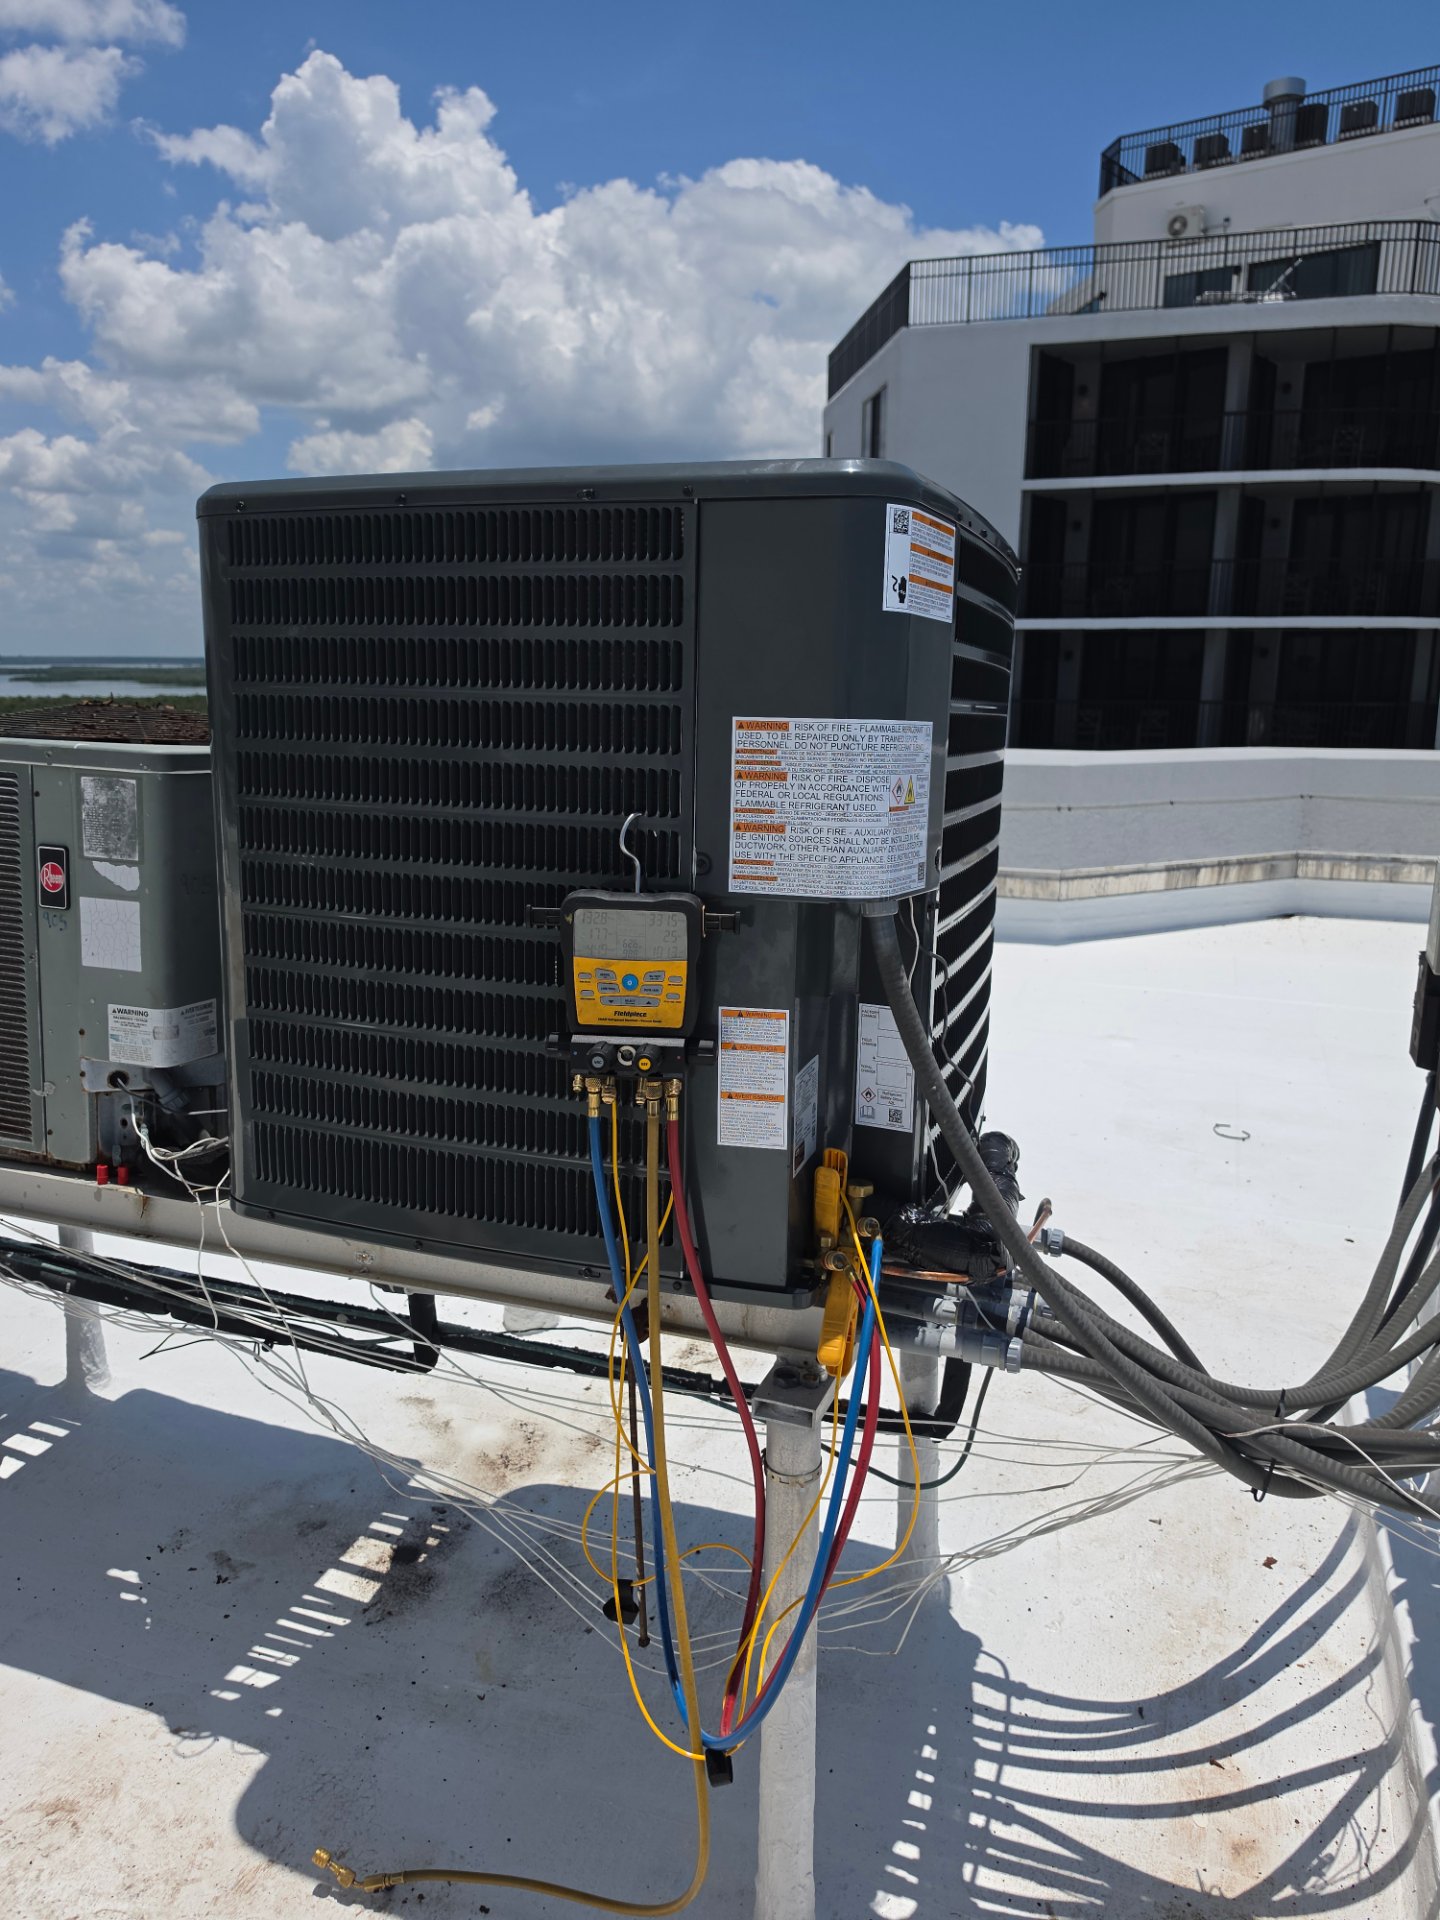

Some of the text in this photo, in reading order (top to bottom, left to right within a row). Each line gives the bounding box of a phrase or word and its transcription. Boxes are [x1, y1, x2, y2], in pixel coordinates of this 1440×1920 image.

[746, 721, 788, 730] WARNING
[794, 723, 815, 732] RISK
[817, 723, 830, 732] OF
[831, 724, 852, 732] FIRE
[859, 725, 901, 733] FLAMMABLE
[737, 732, 763, 740] USED.
[767, 732, 778, 740] TO
[780, 733, 792, 741] BE
[794, 733, 839, 742] REPAIRED
[841, 734, 866, 742] ONLY
[868, 735, 878, 743] BY
[737, 740, 792, 749] PERSONNEL.
[794, 741, 807, 750] DO
[809, 742, 828, 750] NOT
[830, 743, 878, 751] PUNCTURE
[745, 771, 786, 780] WARNING
[791, 773, 812, 782] RISK
[813, 774, 826, 782] OF
[828, 775, 848, 783] FIRE
[855, 775, 890, 784] DISPOSE
[734, 780, 891, 793] OF PROPERLY IN ACCORDANCE WITH
[735, 789, 775, 799] FEDERAL
[777, 791, 791, 799] OR
[792, 791, 821, 800] LOCAL
[735, 799, 786, 809] FLAMMABLE
[788, 801, 851, 811] REFRIGERANT
[743, 824, 785, 833] WARNING
[790, 826, 810, 835] RISK
[812, 827, 825, 835] OF
[826, 828, 847, 836] FIRE
[854, 828, 892, 837] AUXILIARY
[735, 832, 746, 841] BE
[749, 833, 786, 843] IGNITION
[788, 835, 831, 845] SOURCES
[832, 836, 861, 845] SHALL
[862, 837, 880, 846] NOT
[880, 837, 890, 845] BE
[734, 841, 787, 851] DUCTWORK,
[789, 844, 819, 853] OTHER
[821, 845, 845, 854] THAN
[847, 846, 888, 855] AUXILIARY
[734, 850, 752, 859] USE
[753, 851, 777, 860] WITH
[779, 852, 795, 861] THE
[797, 853, 837, 863] SPECIFIC
[116, 1007, 149, 1018] WARNING
[613, 1010, 647, 1018] Fieldpiece
